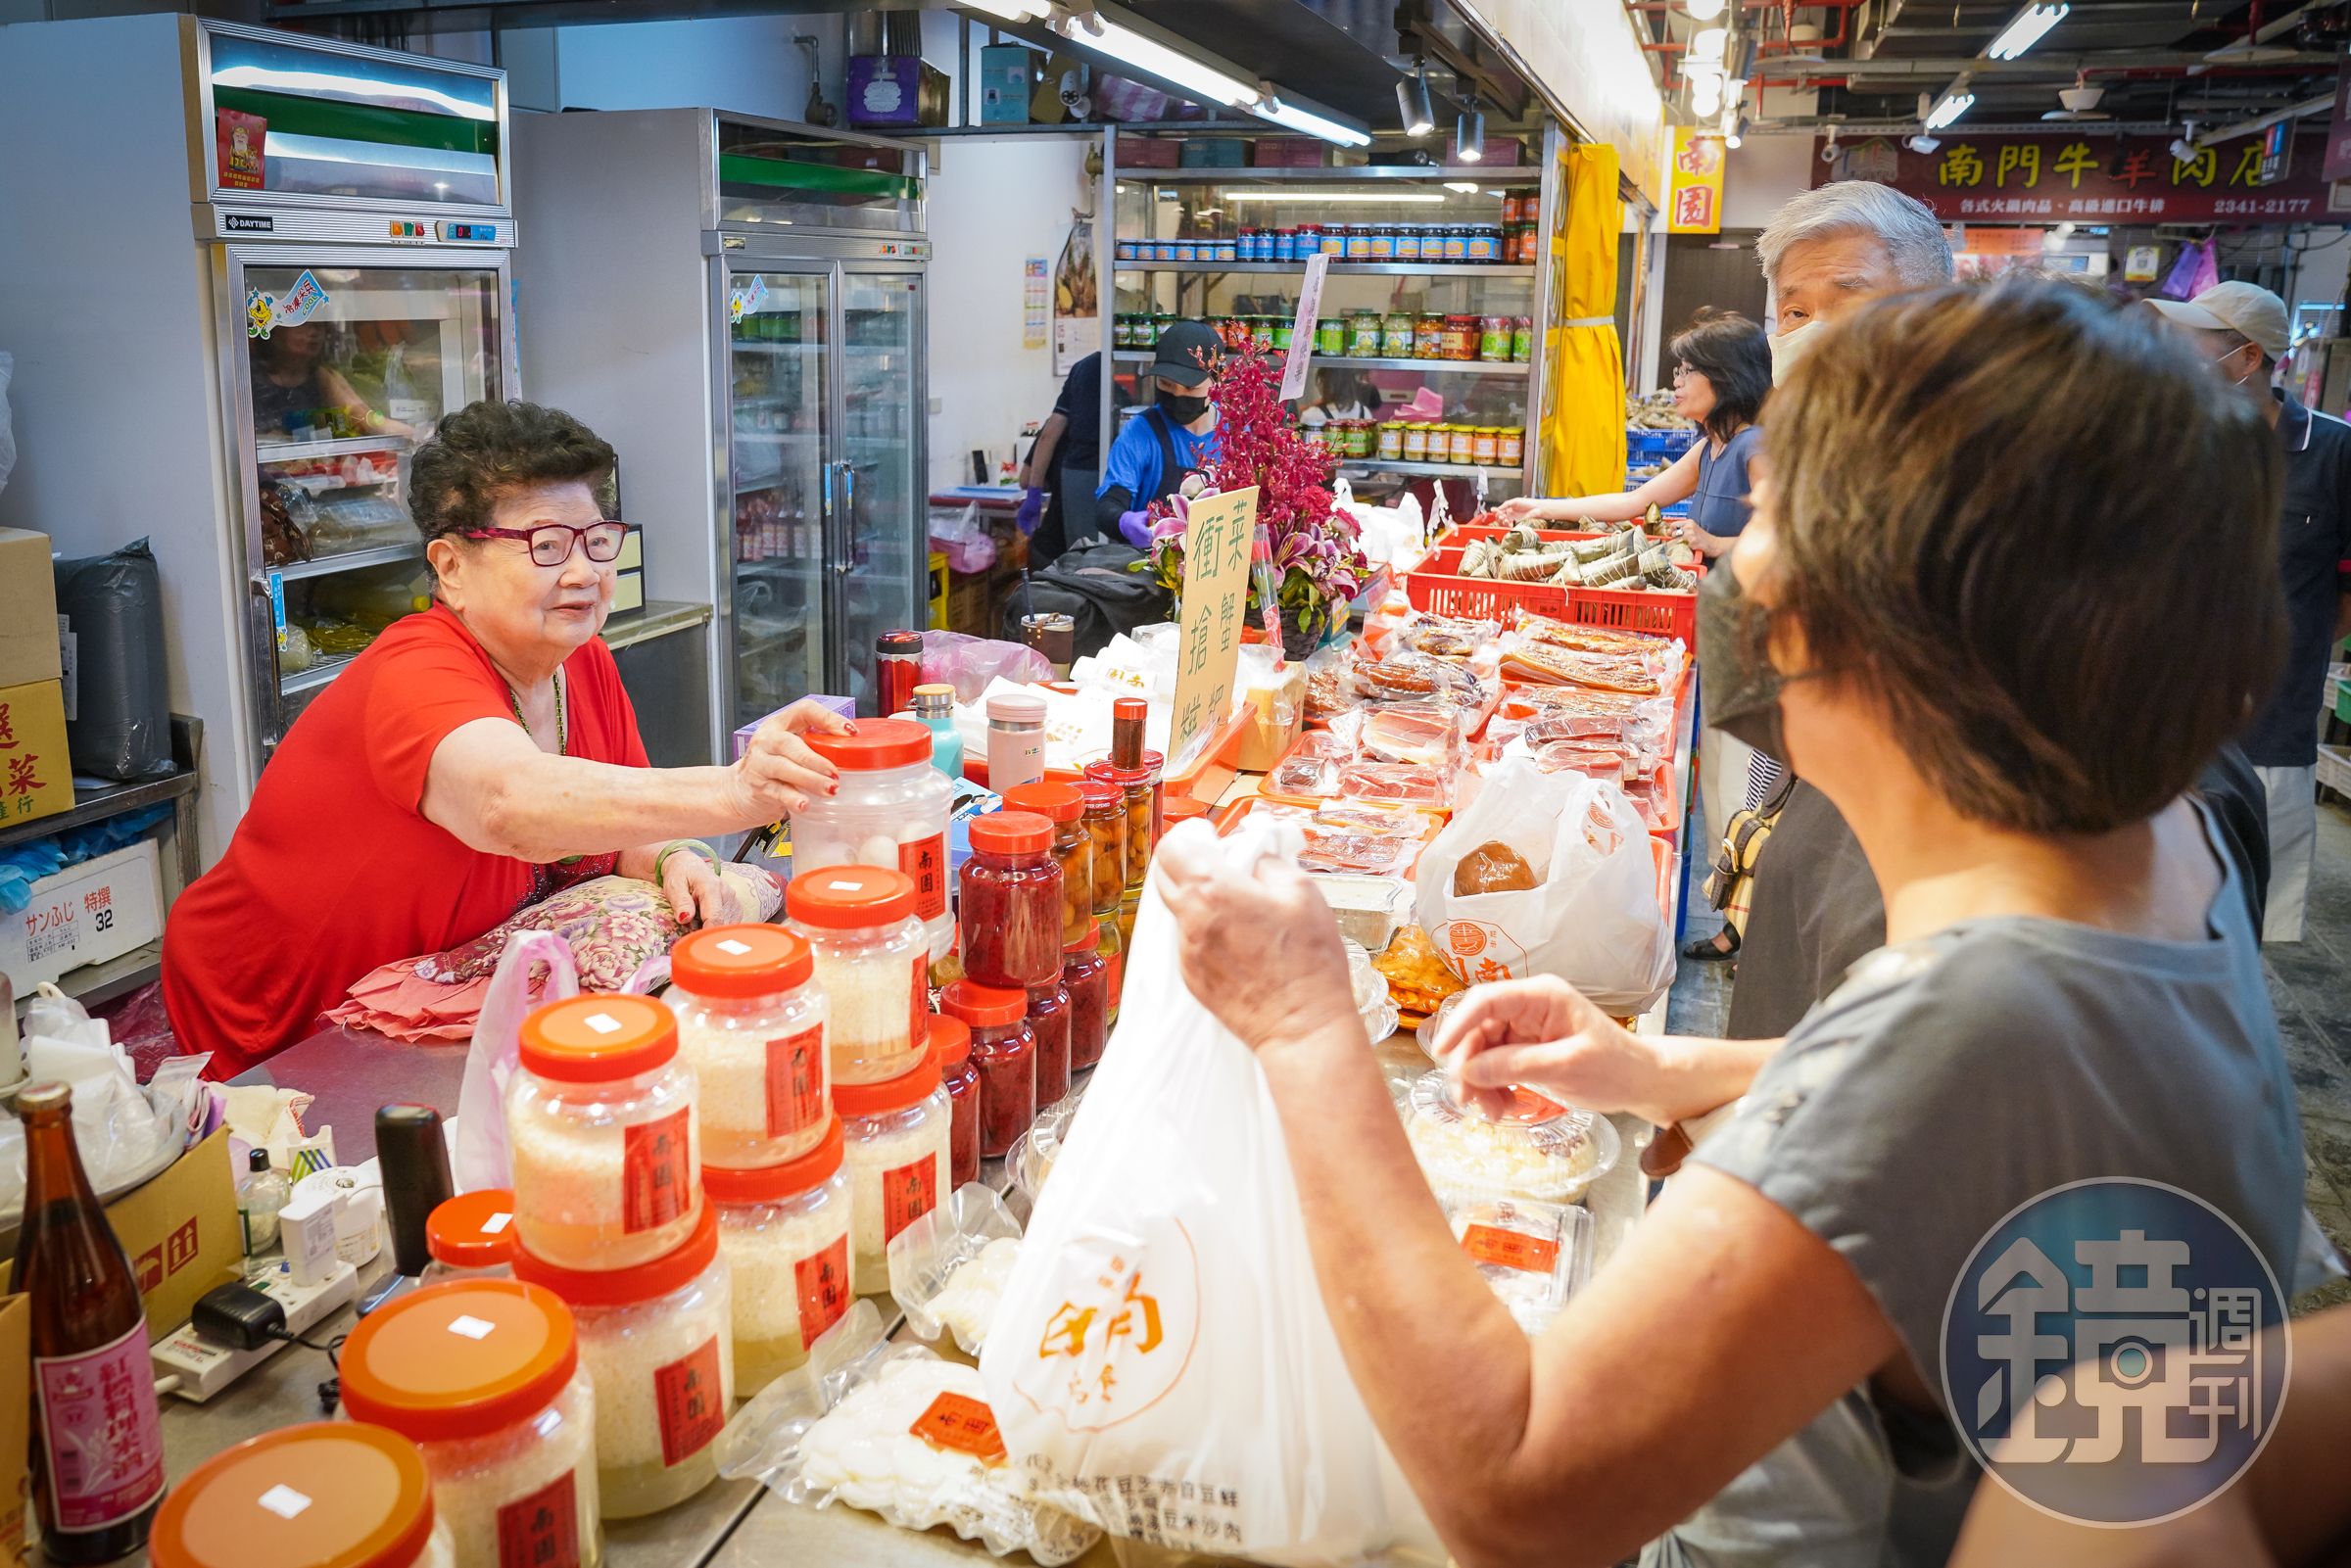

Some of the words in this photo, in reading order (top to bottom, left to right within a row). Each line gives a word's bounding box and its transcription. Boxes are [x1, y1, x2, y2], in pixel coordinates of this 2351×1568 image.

[1676, 135, 1719, 227] 南園
[1939, 139, 2265, 189] 南門牛羊肉店
[240, 219, 271, 229] DAYTIME
[2214, 199, 2312, 214] 2341-2177
[919, 851, 934, 894] 南園
[25, 902, 74, 937] サンふじ
[83, 885, 112, 914] 特撰
[95, 909, 114, 932] 32
[906, 1175, 923, 1220] 南園
[819, 1263, 837, 1308] 南園
[684, 1368, 706, 1420] 南園
